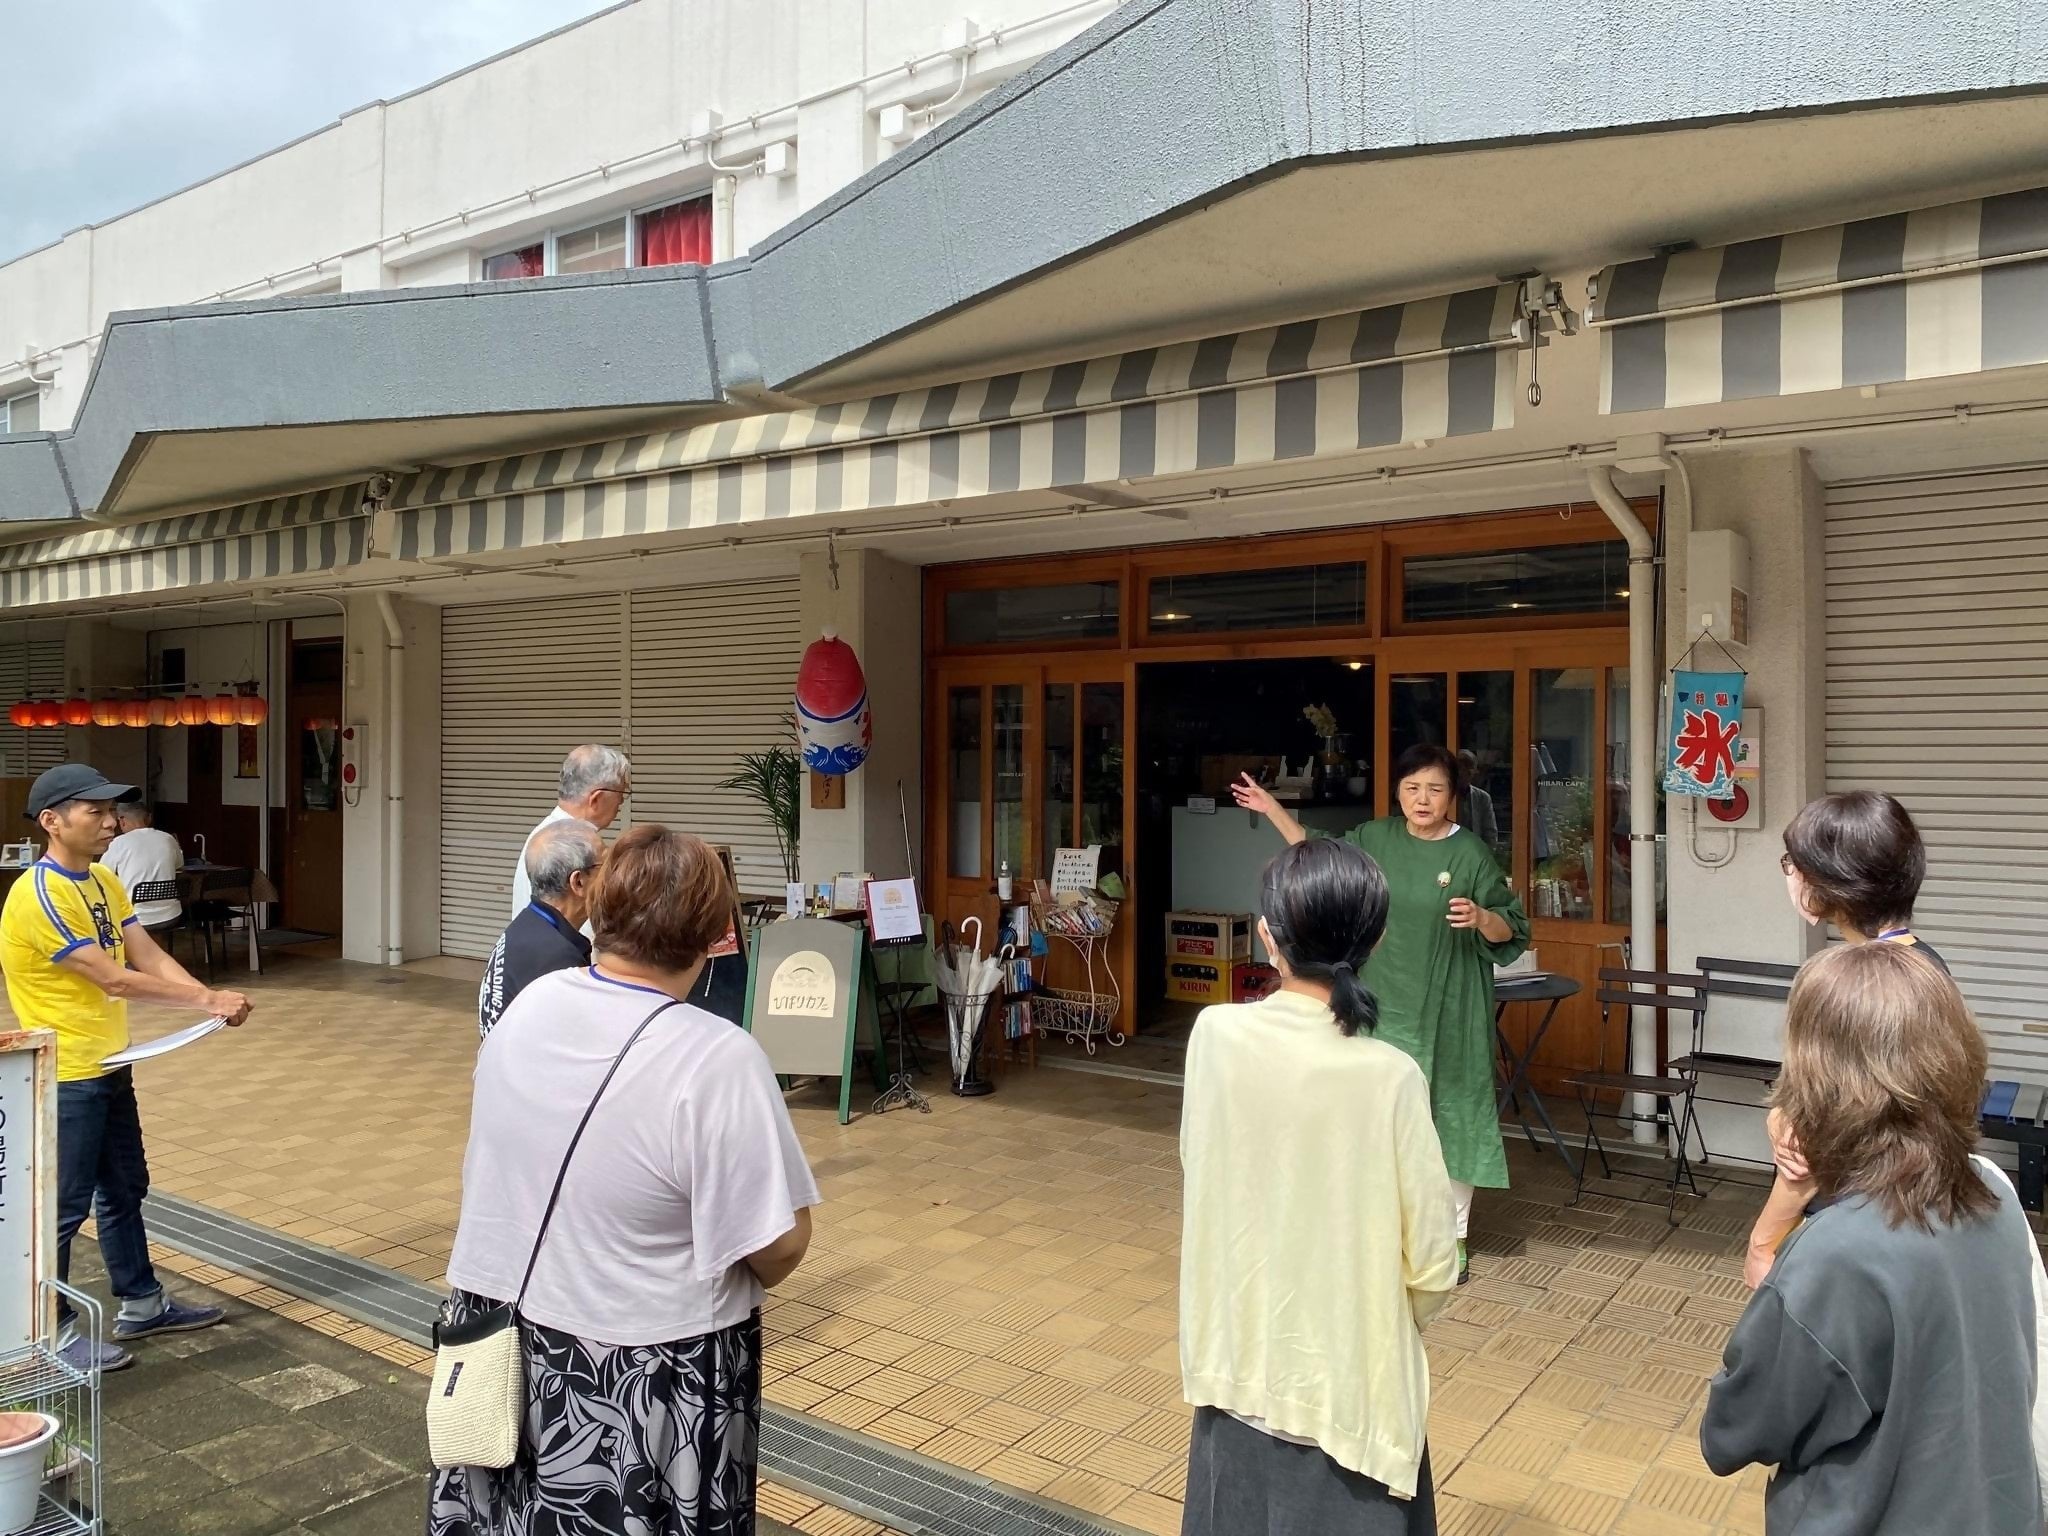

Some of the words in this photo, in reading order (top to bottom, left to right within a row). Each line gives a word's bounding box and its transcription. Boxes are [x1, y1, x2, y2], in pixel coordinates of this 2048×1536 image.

[1674, 708, 1740, 785] 氷
[1179, 981, 1211, 993] KIRIN
[773, 995, 829, 1011] ひばりカフェ
